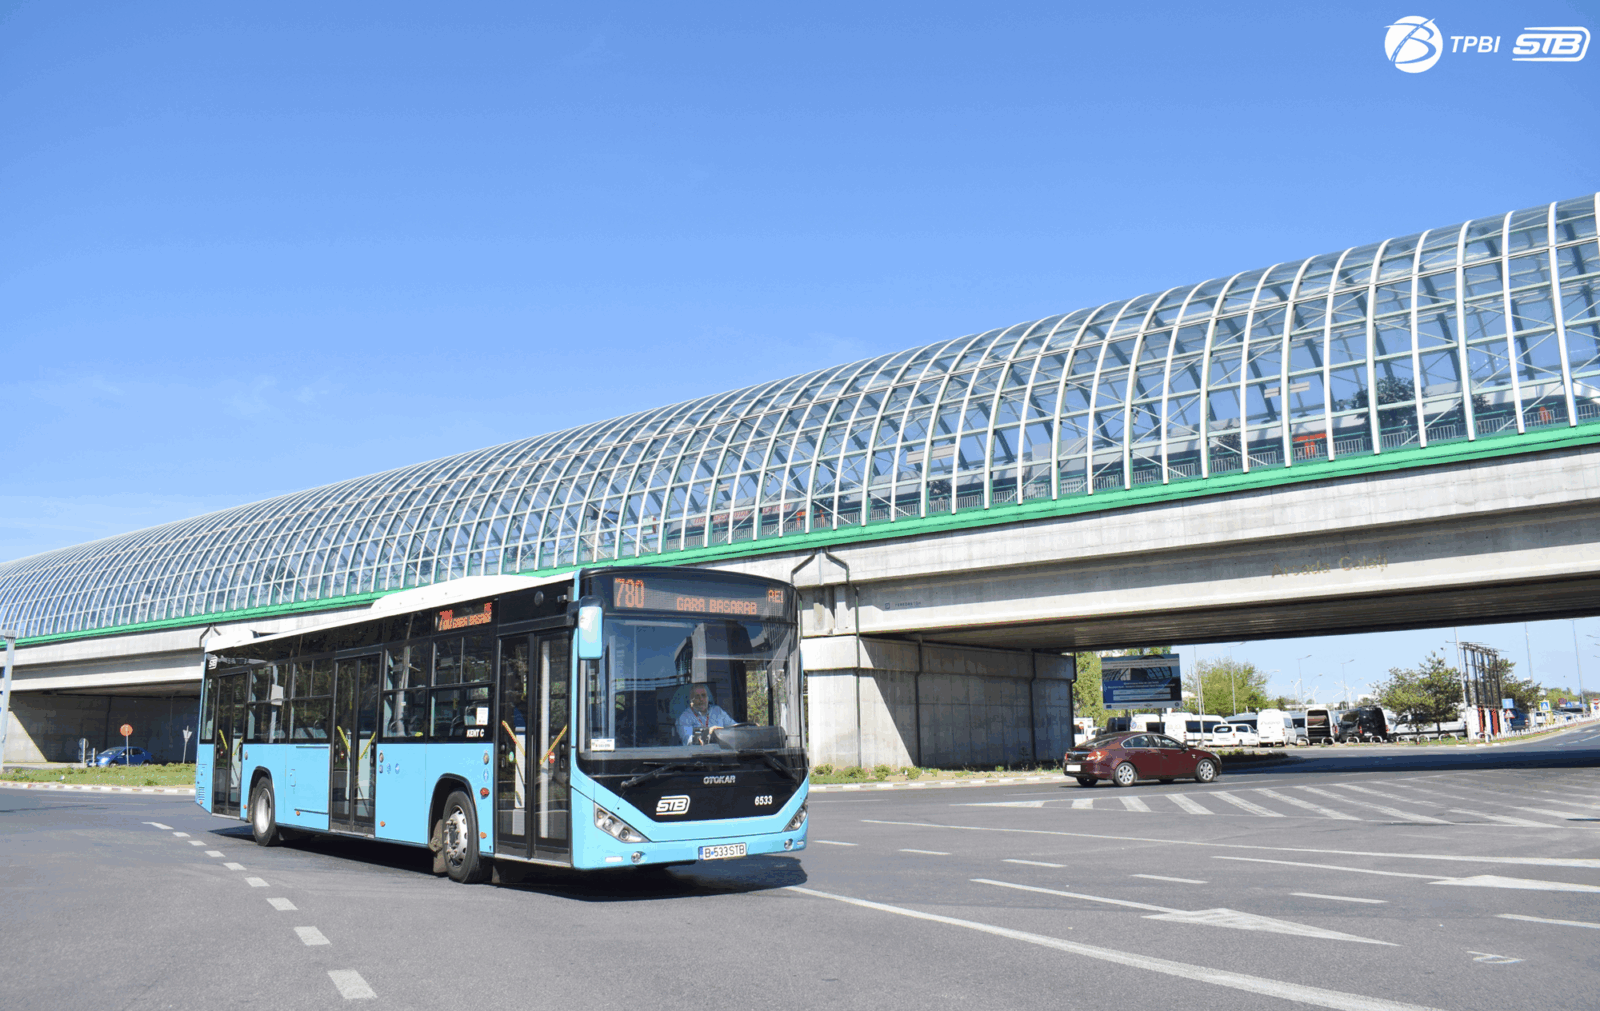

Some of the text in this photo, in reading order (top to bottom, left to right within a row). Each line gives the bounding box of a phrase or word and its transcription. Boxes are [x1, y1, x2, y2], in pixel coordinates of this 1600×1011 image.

[614, 578, 644, 608] 780
[676, 597, 757, 615] GARA BASARAB
[466, 728, 485, 738] KENT C
[703, 774, 736, 785] OTOKAR
[656, 798, 688, 812] STB
[754, 795, 773, 806] 6533
